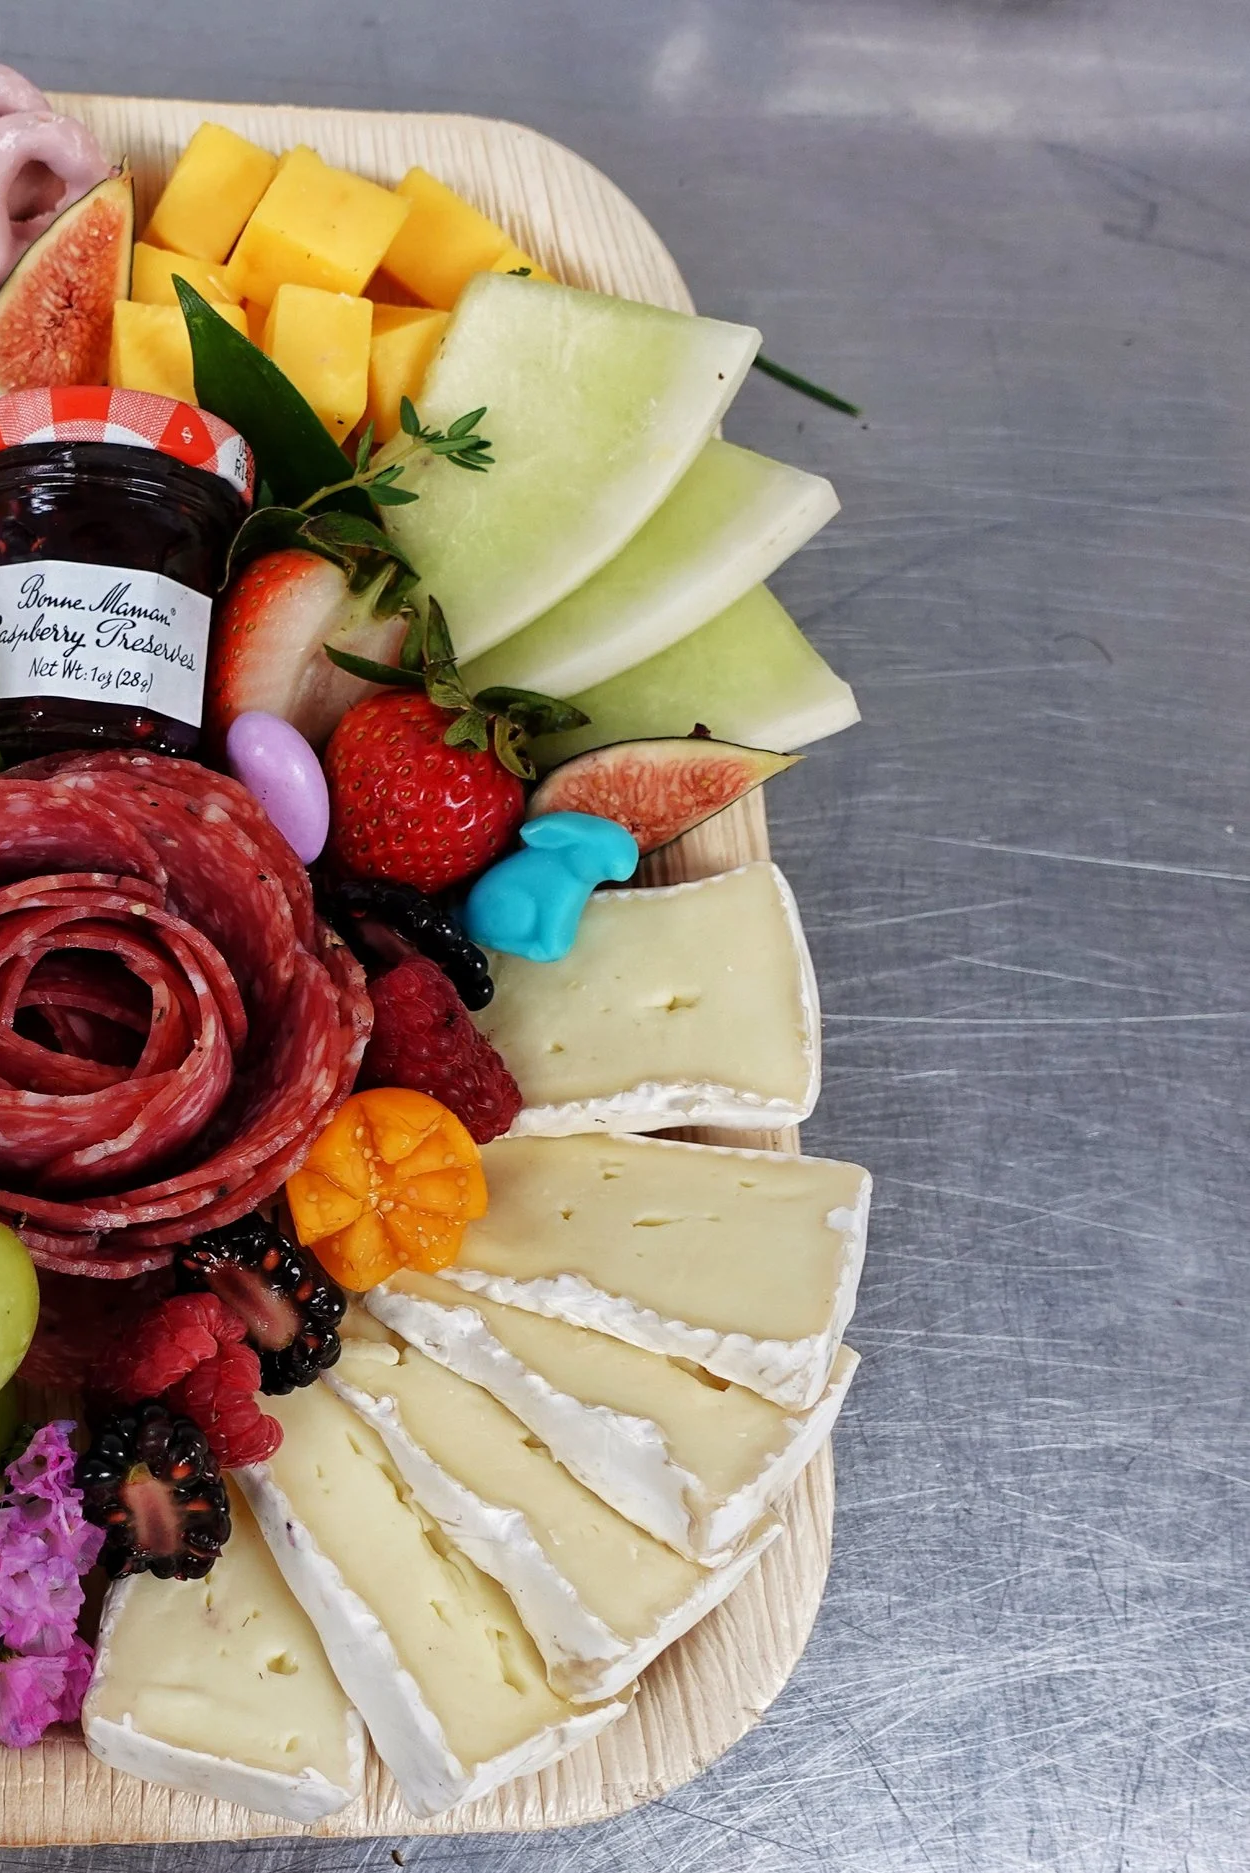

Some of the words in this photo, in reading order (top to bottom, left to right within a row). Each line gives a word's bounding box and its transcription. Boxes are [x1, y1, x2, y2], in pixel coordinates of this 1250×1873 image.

[18, 573, 85, 610] Bonne
[95, 618, 196, 671] Preserves
[28, 657, 58, 679] Net
[115, 669, 154, 693] (28g)
